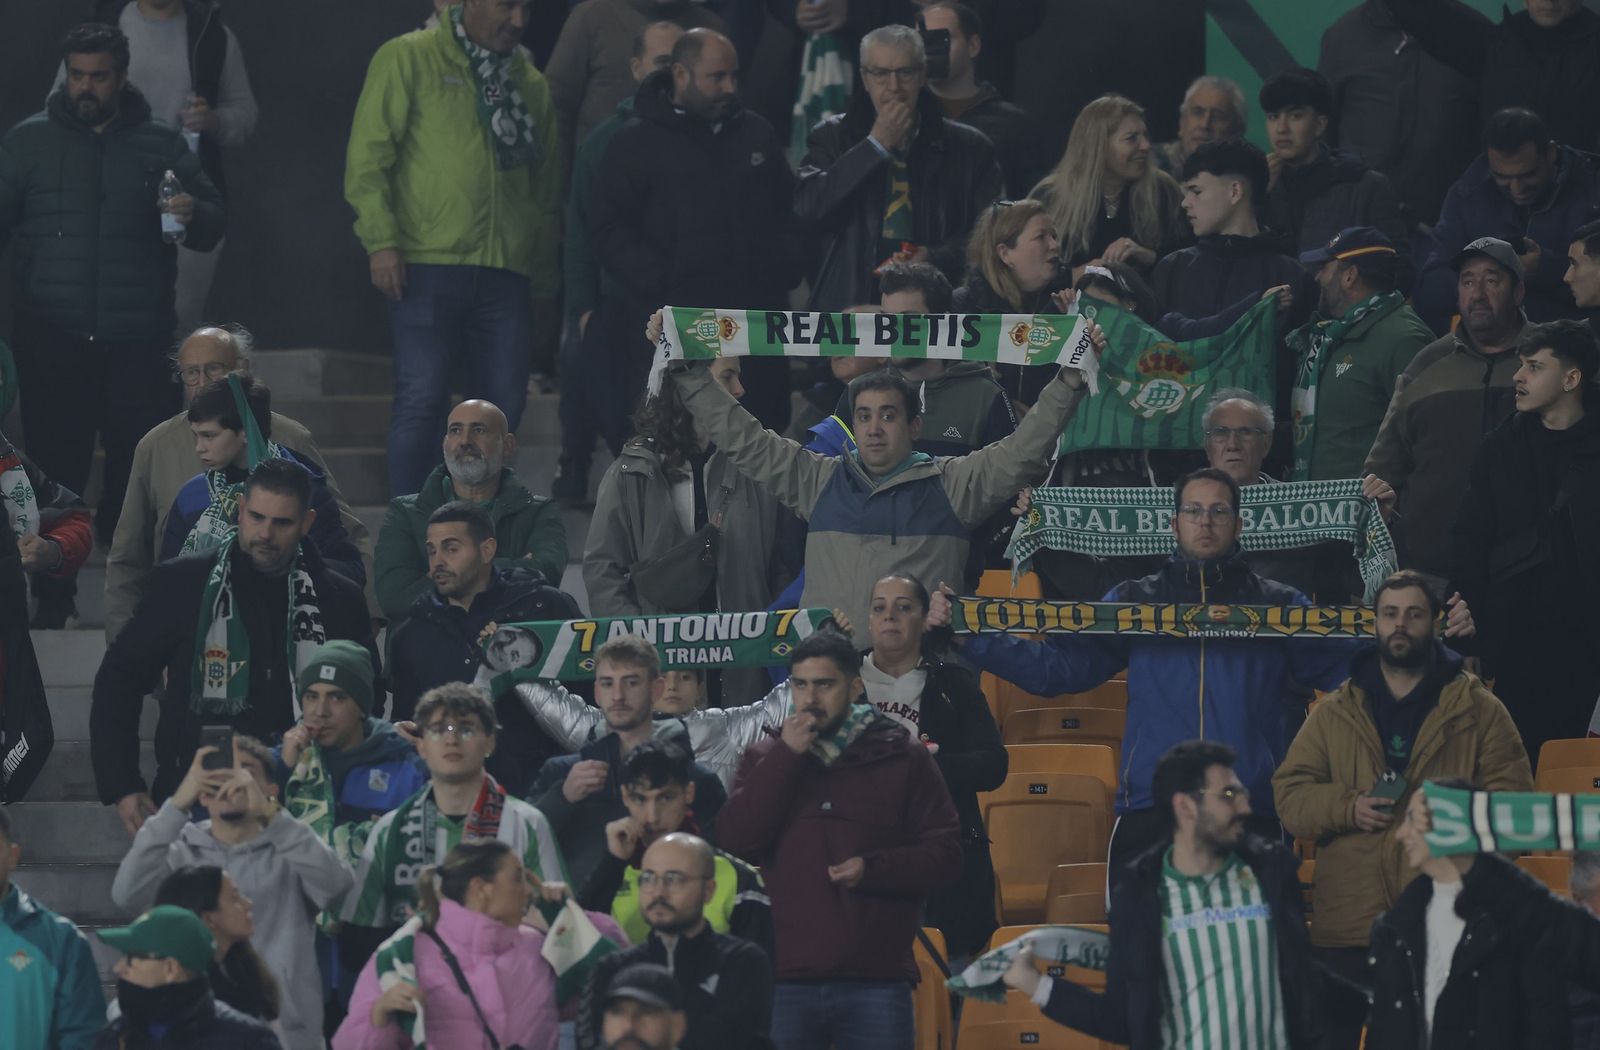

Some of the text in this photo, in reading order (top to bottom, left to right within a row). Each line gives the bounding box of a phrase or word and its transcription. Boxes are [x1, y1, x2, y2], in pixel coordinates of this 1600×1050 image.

[765, 311, 981, 348] REAL BETIS
[1044, 504, 1128, 534] REAL
[1240, 500, 1366, 531] BALOMP
[1367, 552, 1387, 568] ETIS
[571, 608, 800, 653] 7 ANTONIO 7
[1265, 605, 1377, 636] VER
[665, 645, 735, 666] TRIANA
[3, 731, 30, 776] mmel
